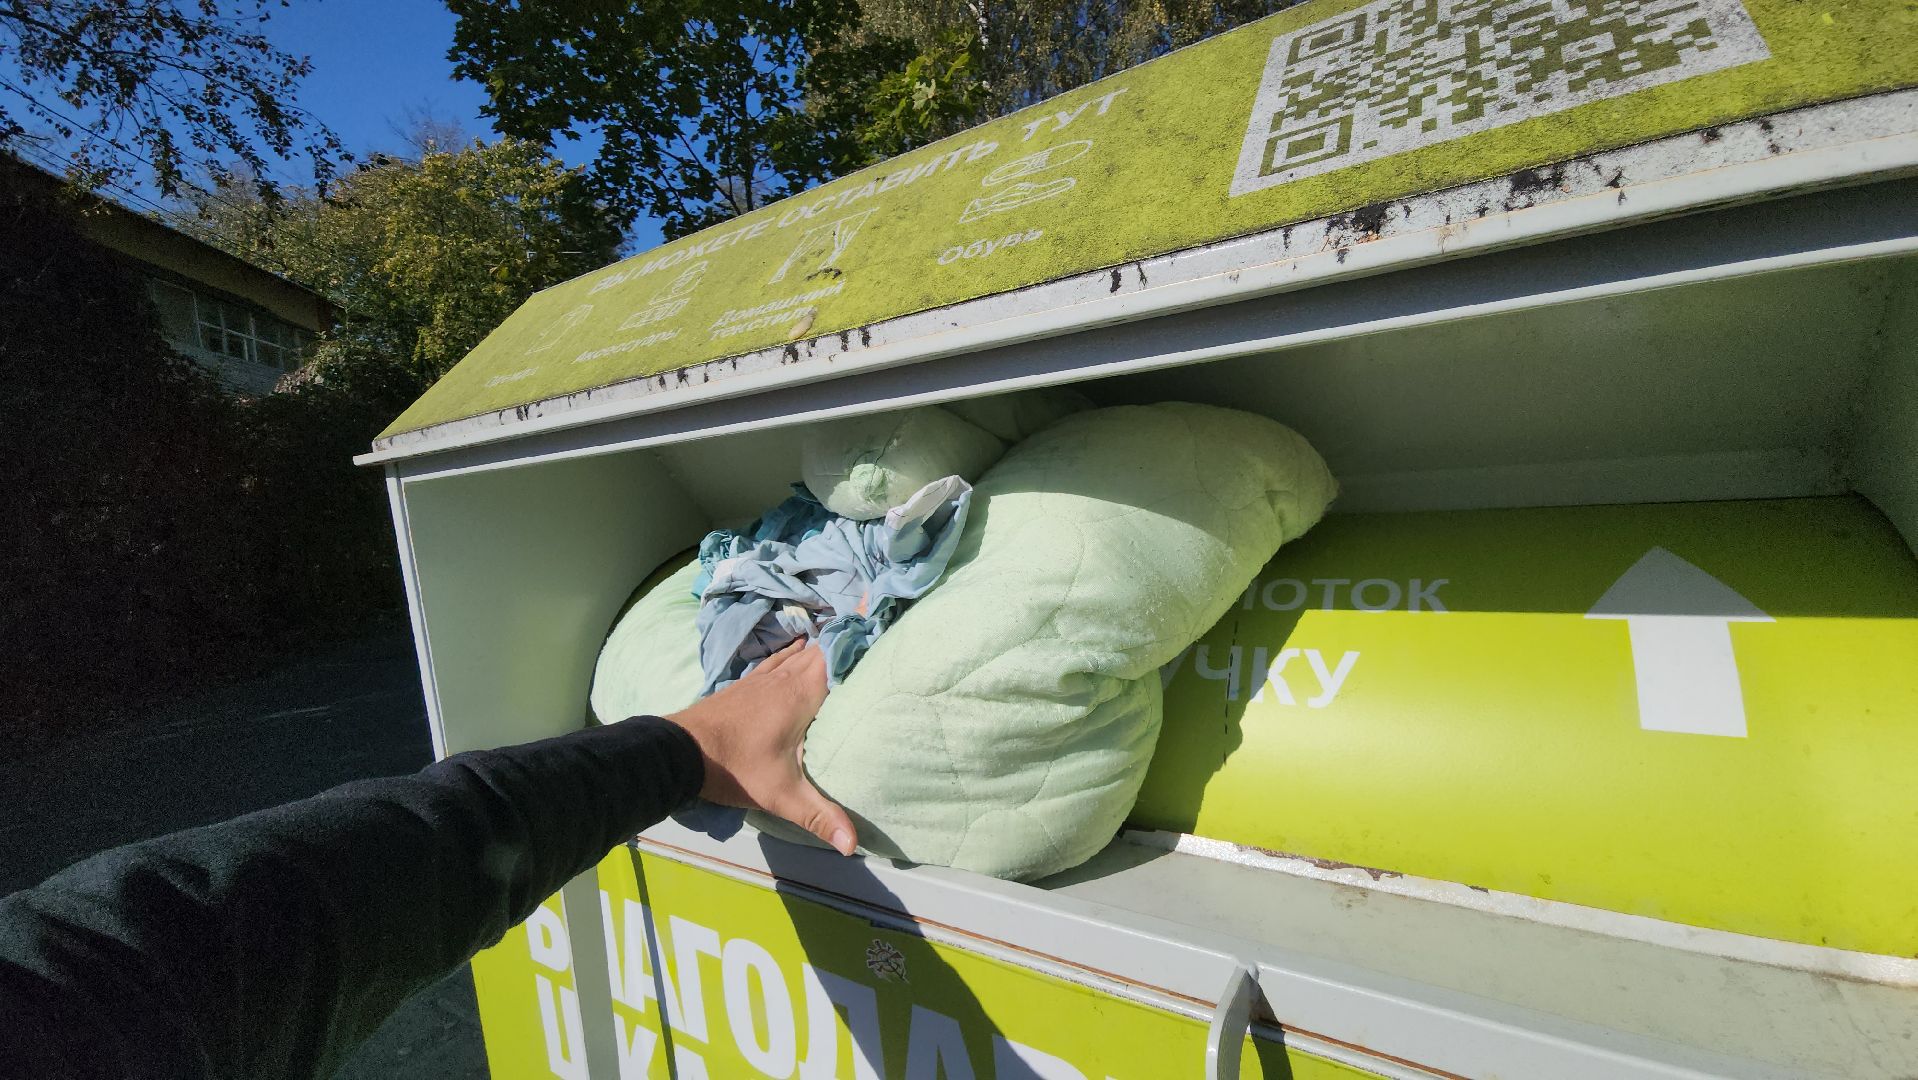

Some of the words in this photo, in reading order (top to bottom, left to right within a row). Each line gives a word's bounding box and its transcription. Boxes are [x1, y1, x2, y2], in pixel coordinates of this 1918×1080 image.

[588, 267, 637, 295] ВЫ
[634, 217, 776, 279] МОЖЕТЕ
[778, 141, 999, 228] ОСТАВИТЬ
[1023, 88, 1129, 141] ТУТ
[937, 229, 1043, 265] Обувь
[708, 278, 847, 331] Домашний
[571, 328, 683, 364] Аксессуары
